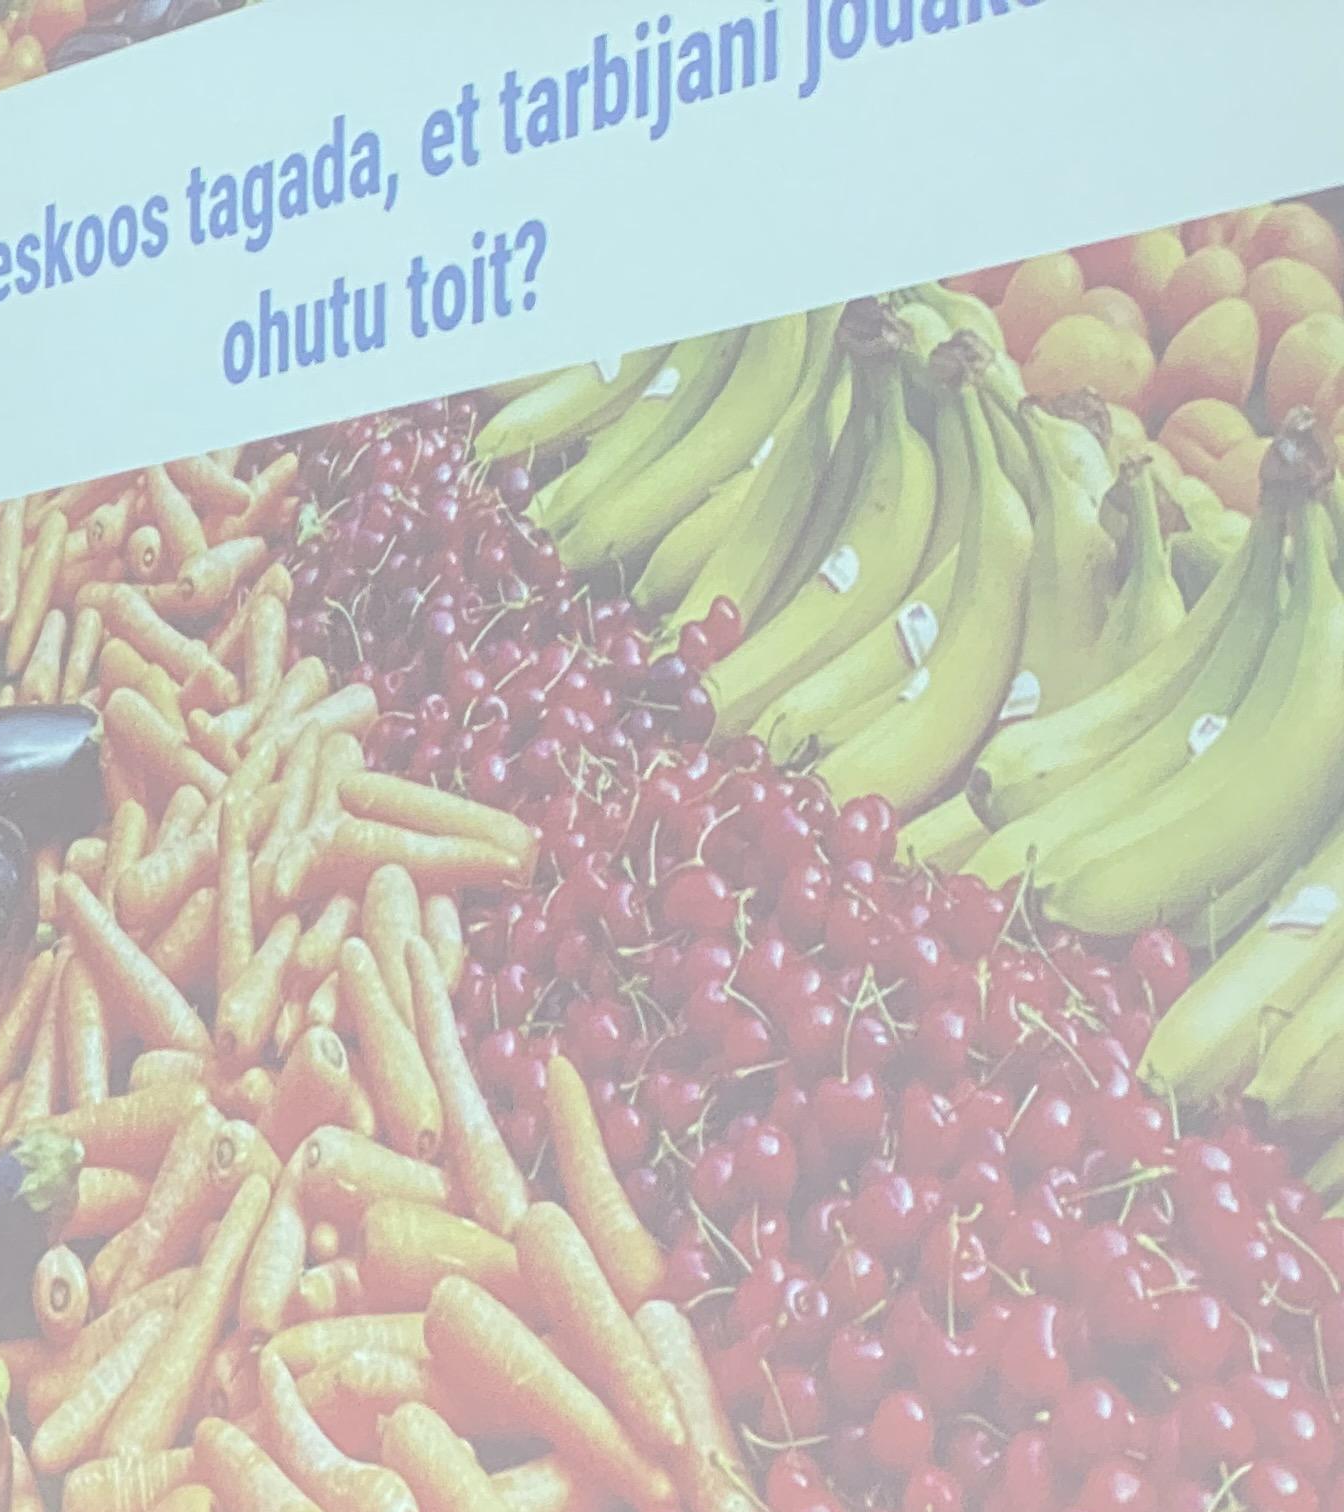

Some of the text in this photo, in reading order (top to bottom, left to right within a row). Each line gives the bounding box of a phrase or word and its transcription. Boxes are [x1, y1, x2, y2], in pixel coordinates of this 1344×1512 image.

[185, 114, 400, 254] tagada,
[421, 82, 481, 177] et
[499, 6, 779, 155] tarbijani
[223, 218, 549, 385] ohutu toit?
